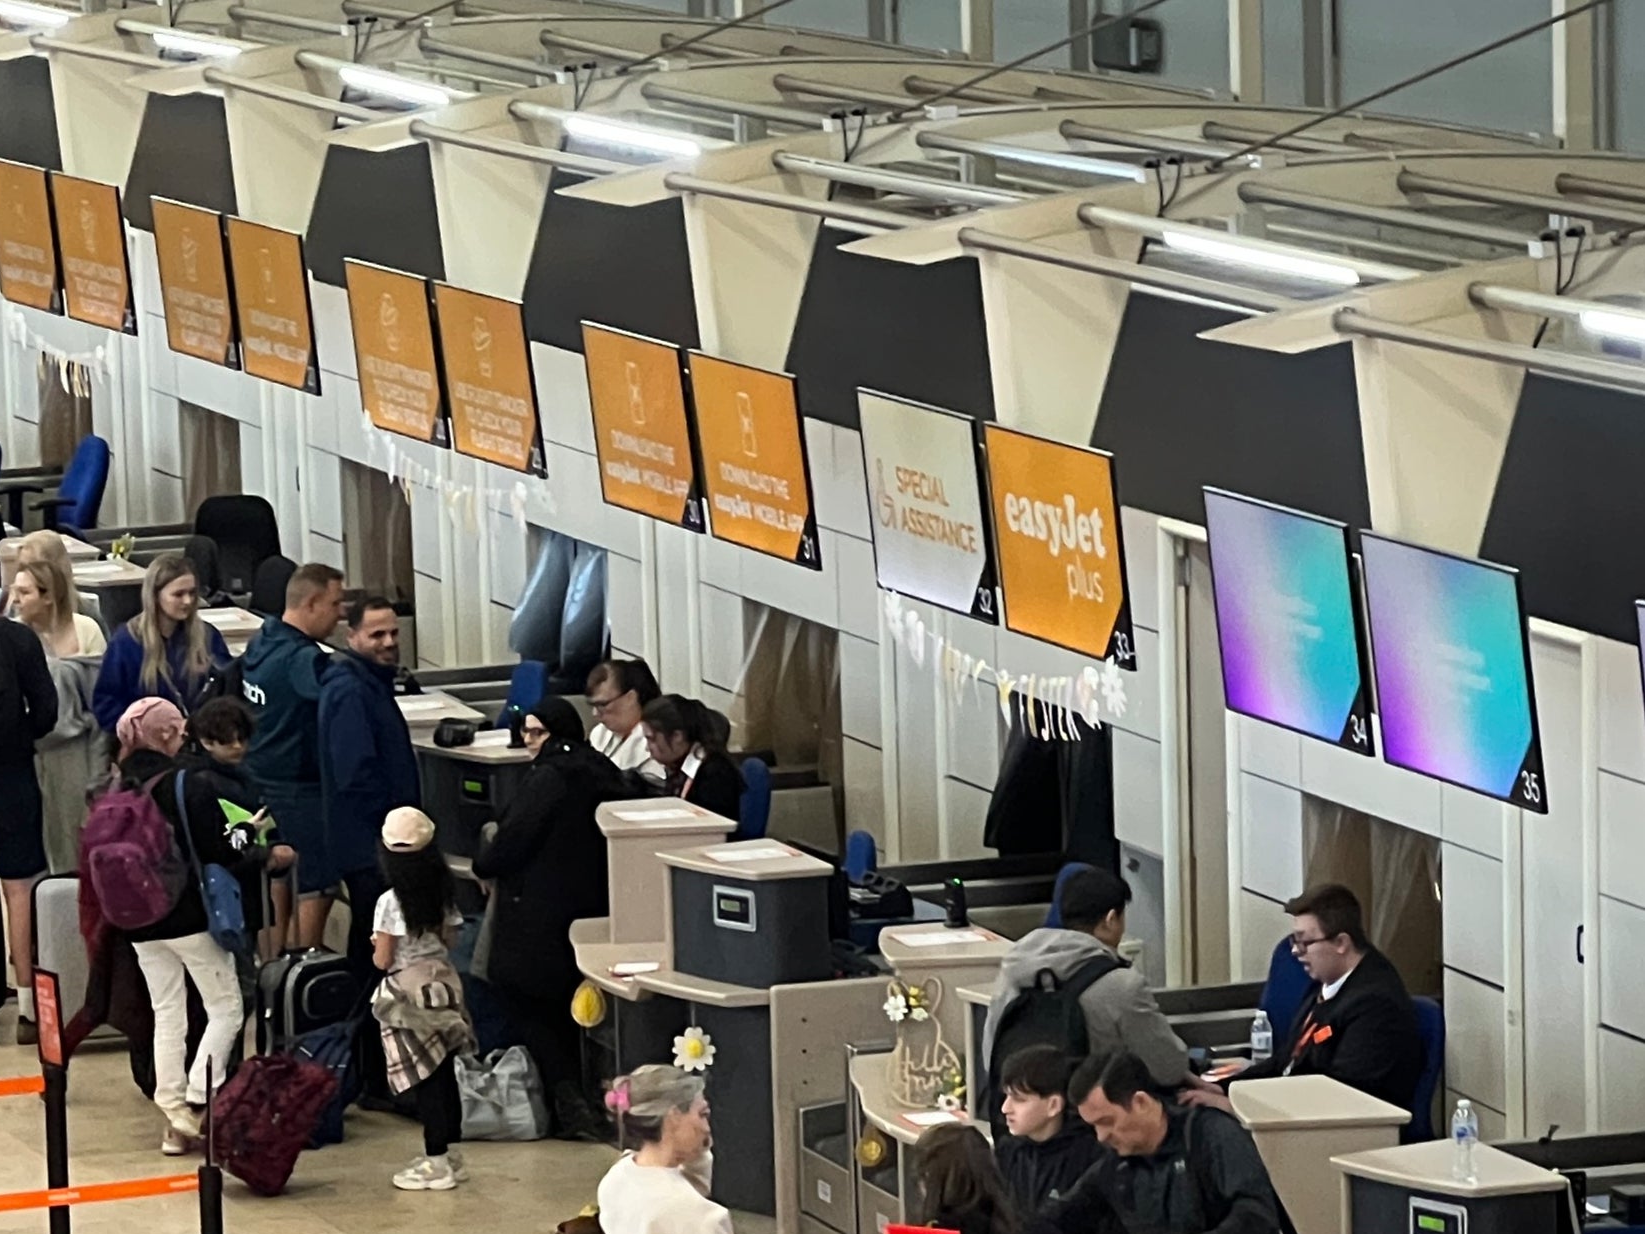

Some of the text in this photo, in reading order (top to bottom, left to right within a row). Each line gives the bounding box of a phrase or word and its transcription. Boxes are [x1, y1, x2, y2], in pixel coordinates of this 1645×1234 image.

[895, 465, 950, 508] SPECIAL
[901, 507, 978, 554] ASSISTANCE
[1005, 492, 1107, 559] easyJet
[801, 534, 818, 561] 31
[1066, 554, 1104, 604] plus
[978, 586, 994, 616] 32
[1113, 630, 1133, 661] 33
[1350, 713, 1369, 747] 34
[1520, 769, 1542, 805] 35
